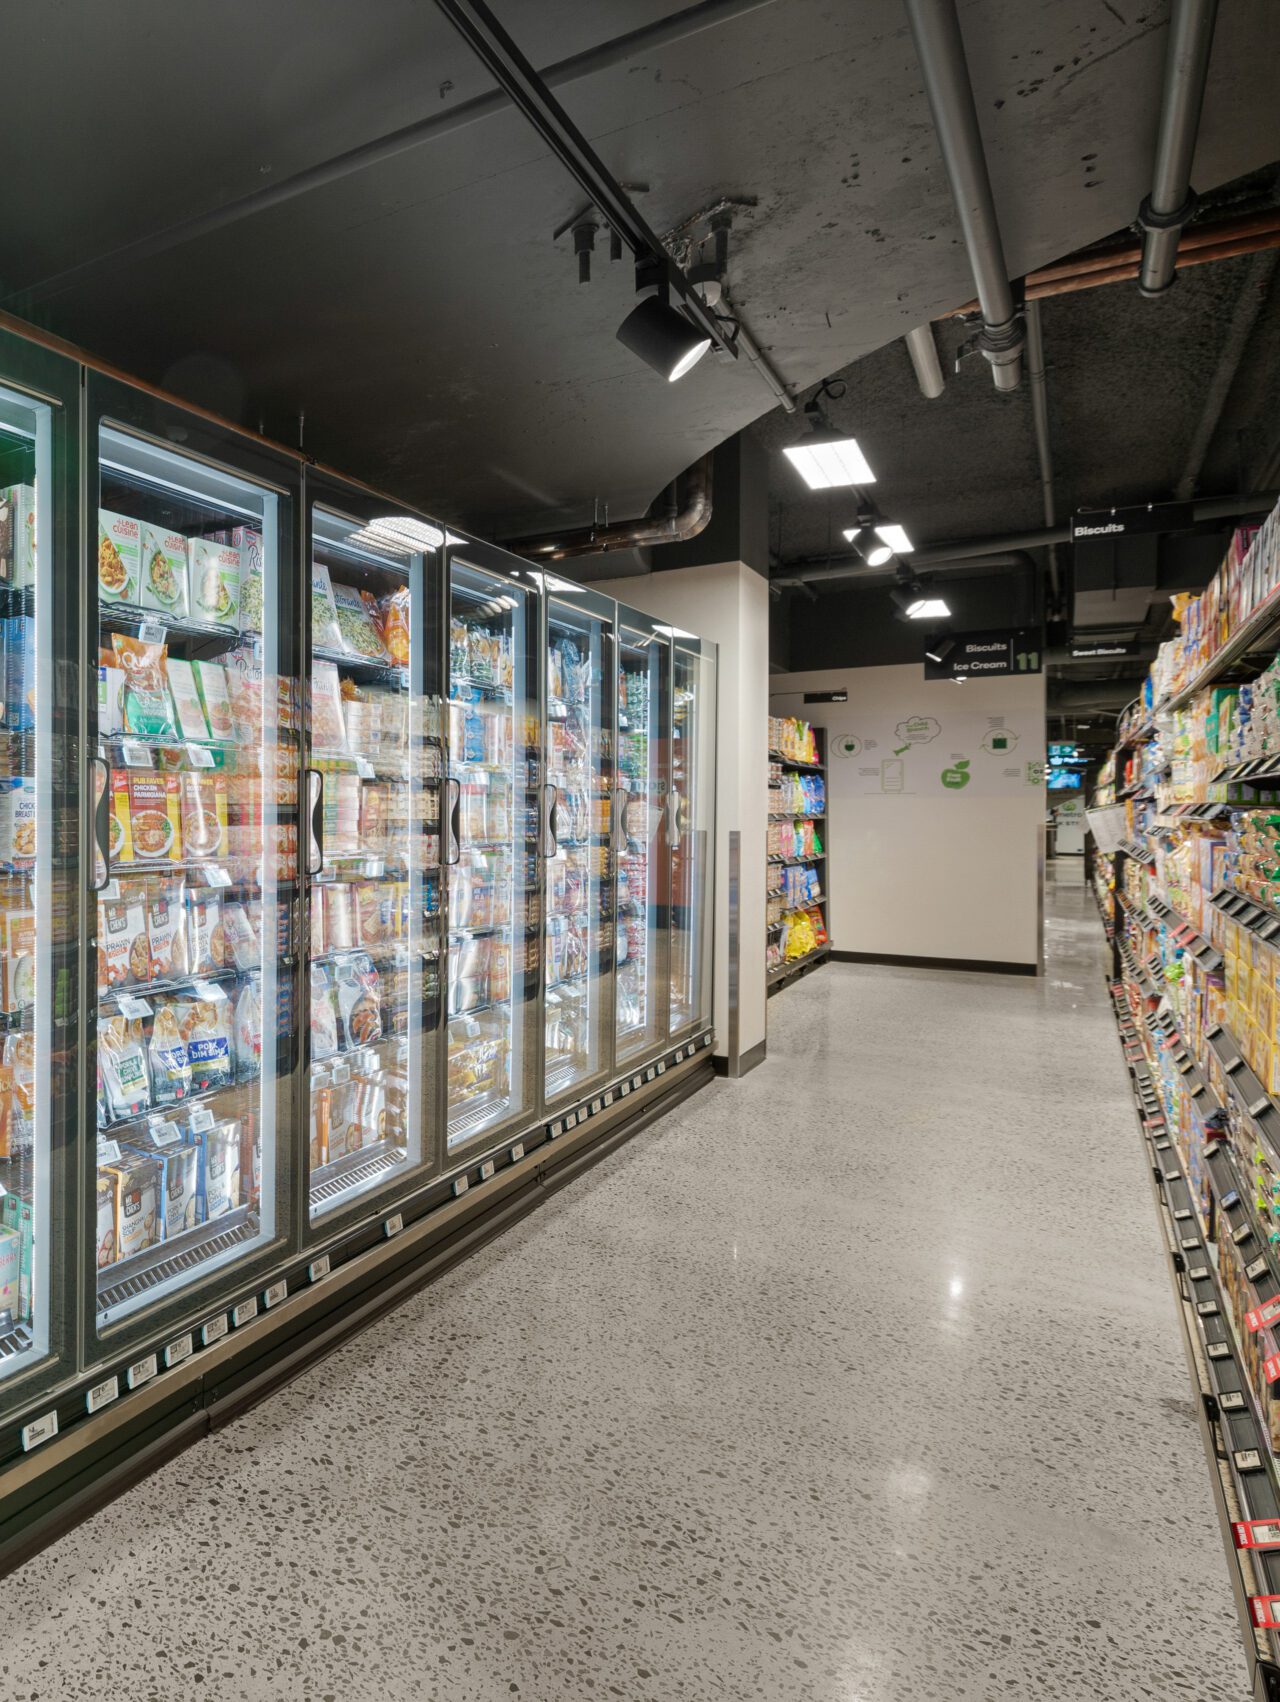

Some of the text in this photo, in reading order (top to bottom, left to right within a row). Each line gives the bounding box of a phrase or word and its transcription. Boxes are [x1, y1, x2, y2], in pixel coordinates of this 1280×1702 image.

[121, 519, 139, 531] Lean
[1074, 523, 1126, 537] Biscuits
[169, 536, 186, 546] Lean
[223, 550, 241, 560] Lean
[965, 642, 1008, 653] Biscuits
[1072, 647, 1127, 657] Sweet Biscuits
[953, 661, 1008, 671] Ice Cream
[1016, 652, 1039, 671] 11
[831, 695, 847, 703] Chips
[133, 777, 145, 785] PUB
[133, 791, 167, 799] PARMIGIANA
[15, 810, 33, 818] BREAST
[192, 1049, 208, 1059] DIM
